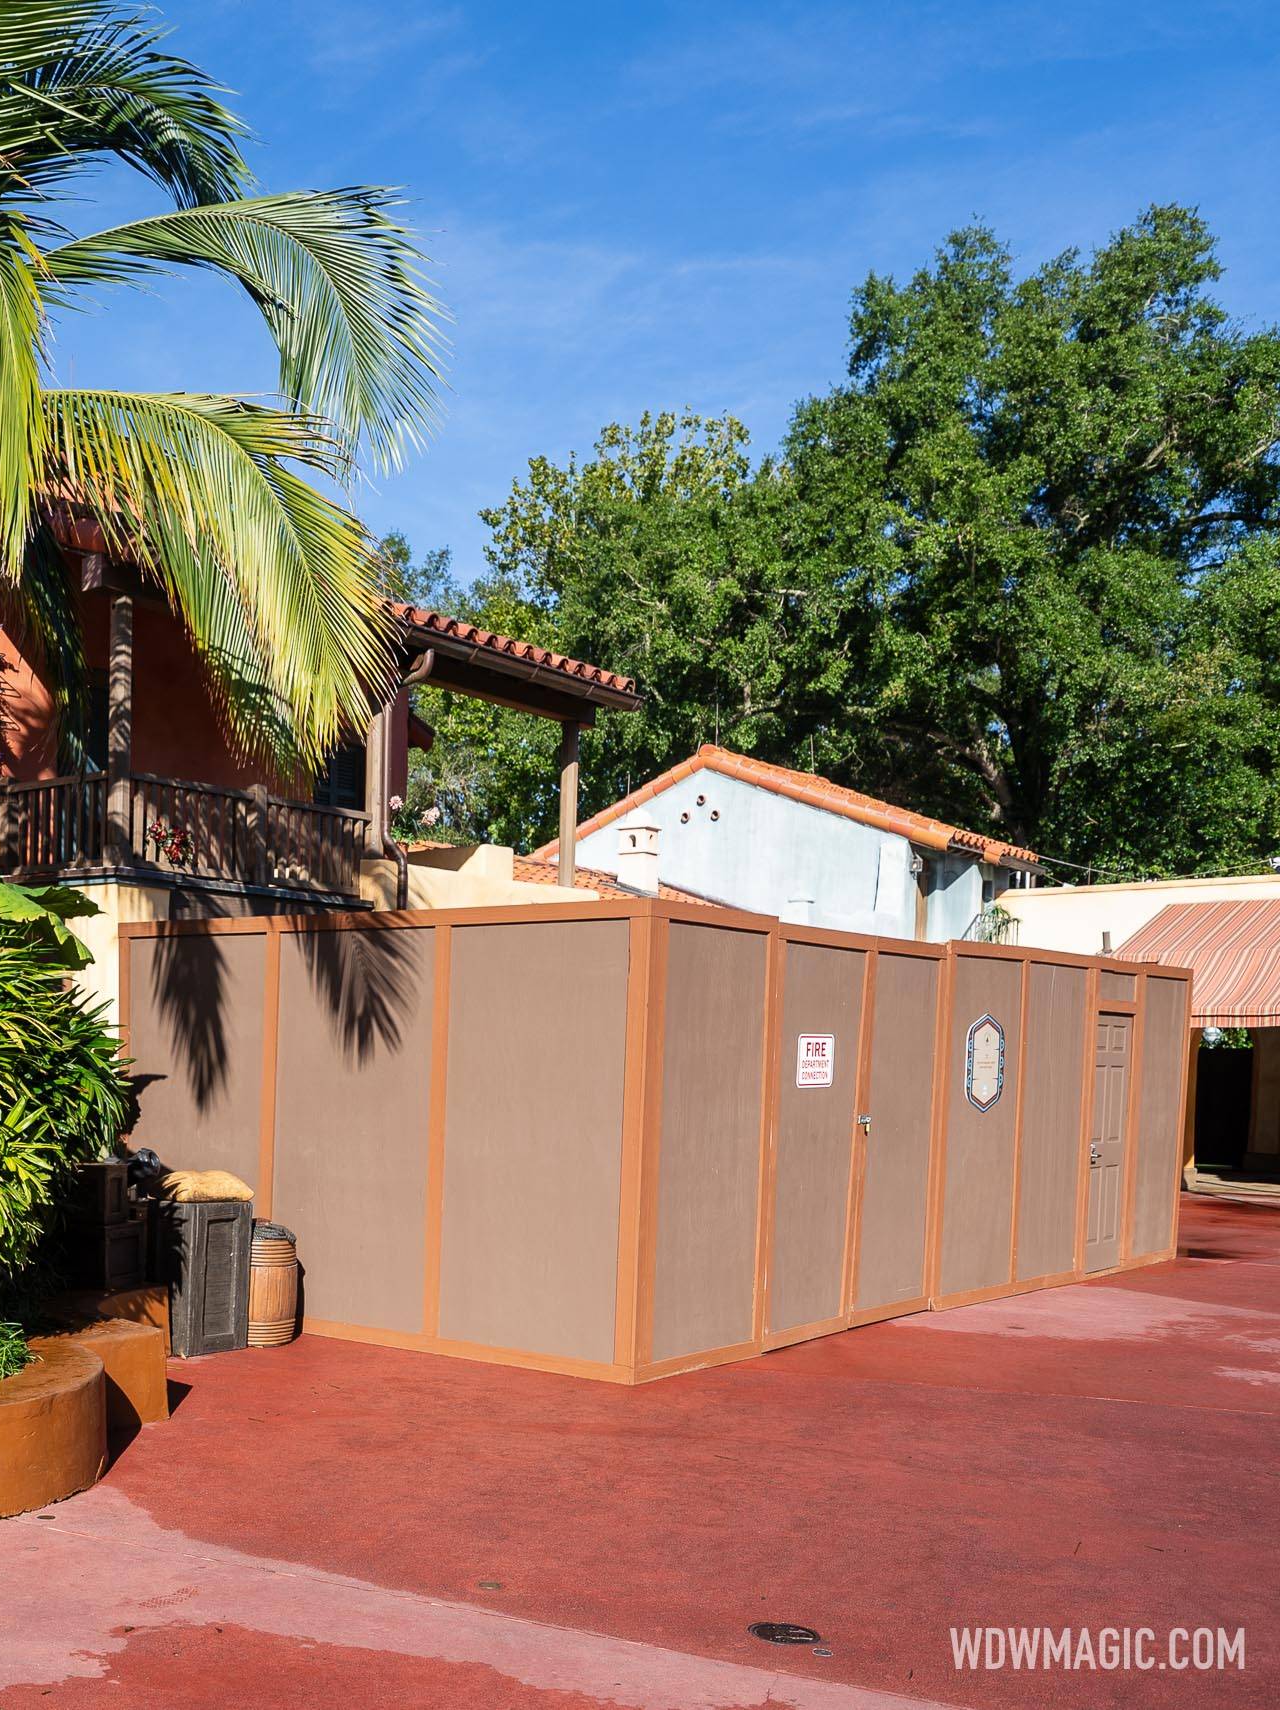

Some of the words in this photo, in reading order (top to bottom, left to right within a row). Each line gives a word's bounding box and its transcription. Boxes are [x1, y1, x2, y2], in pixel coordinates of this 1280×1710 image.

[806, 1042, 826, 1057] FIRE
[802, 1059, 829, 1069] DEPARTMENT
[802, 1071, 827, 1080] CONNECTION
